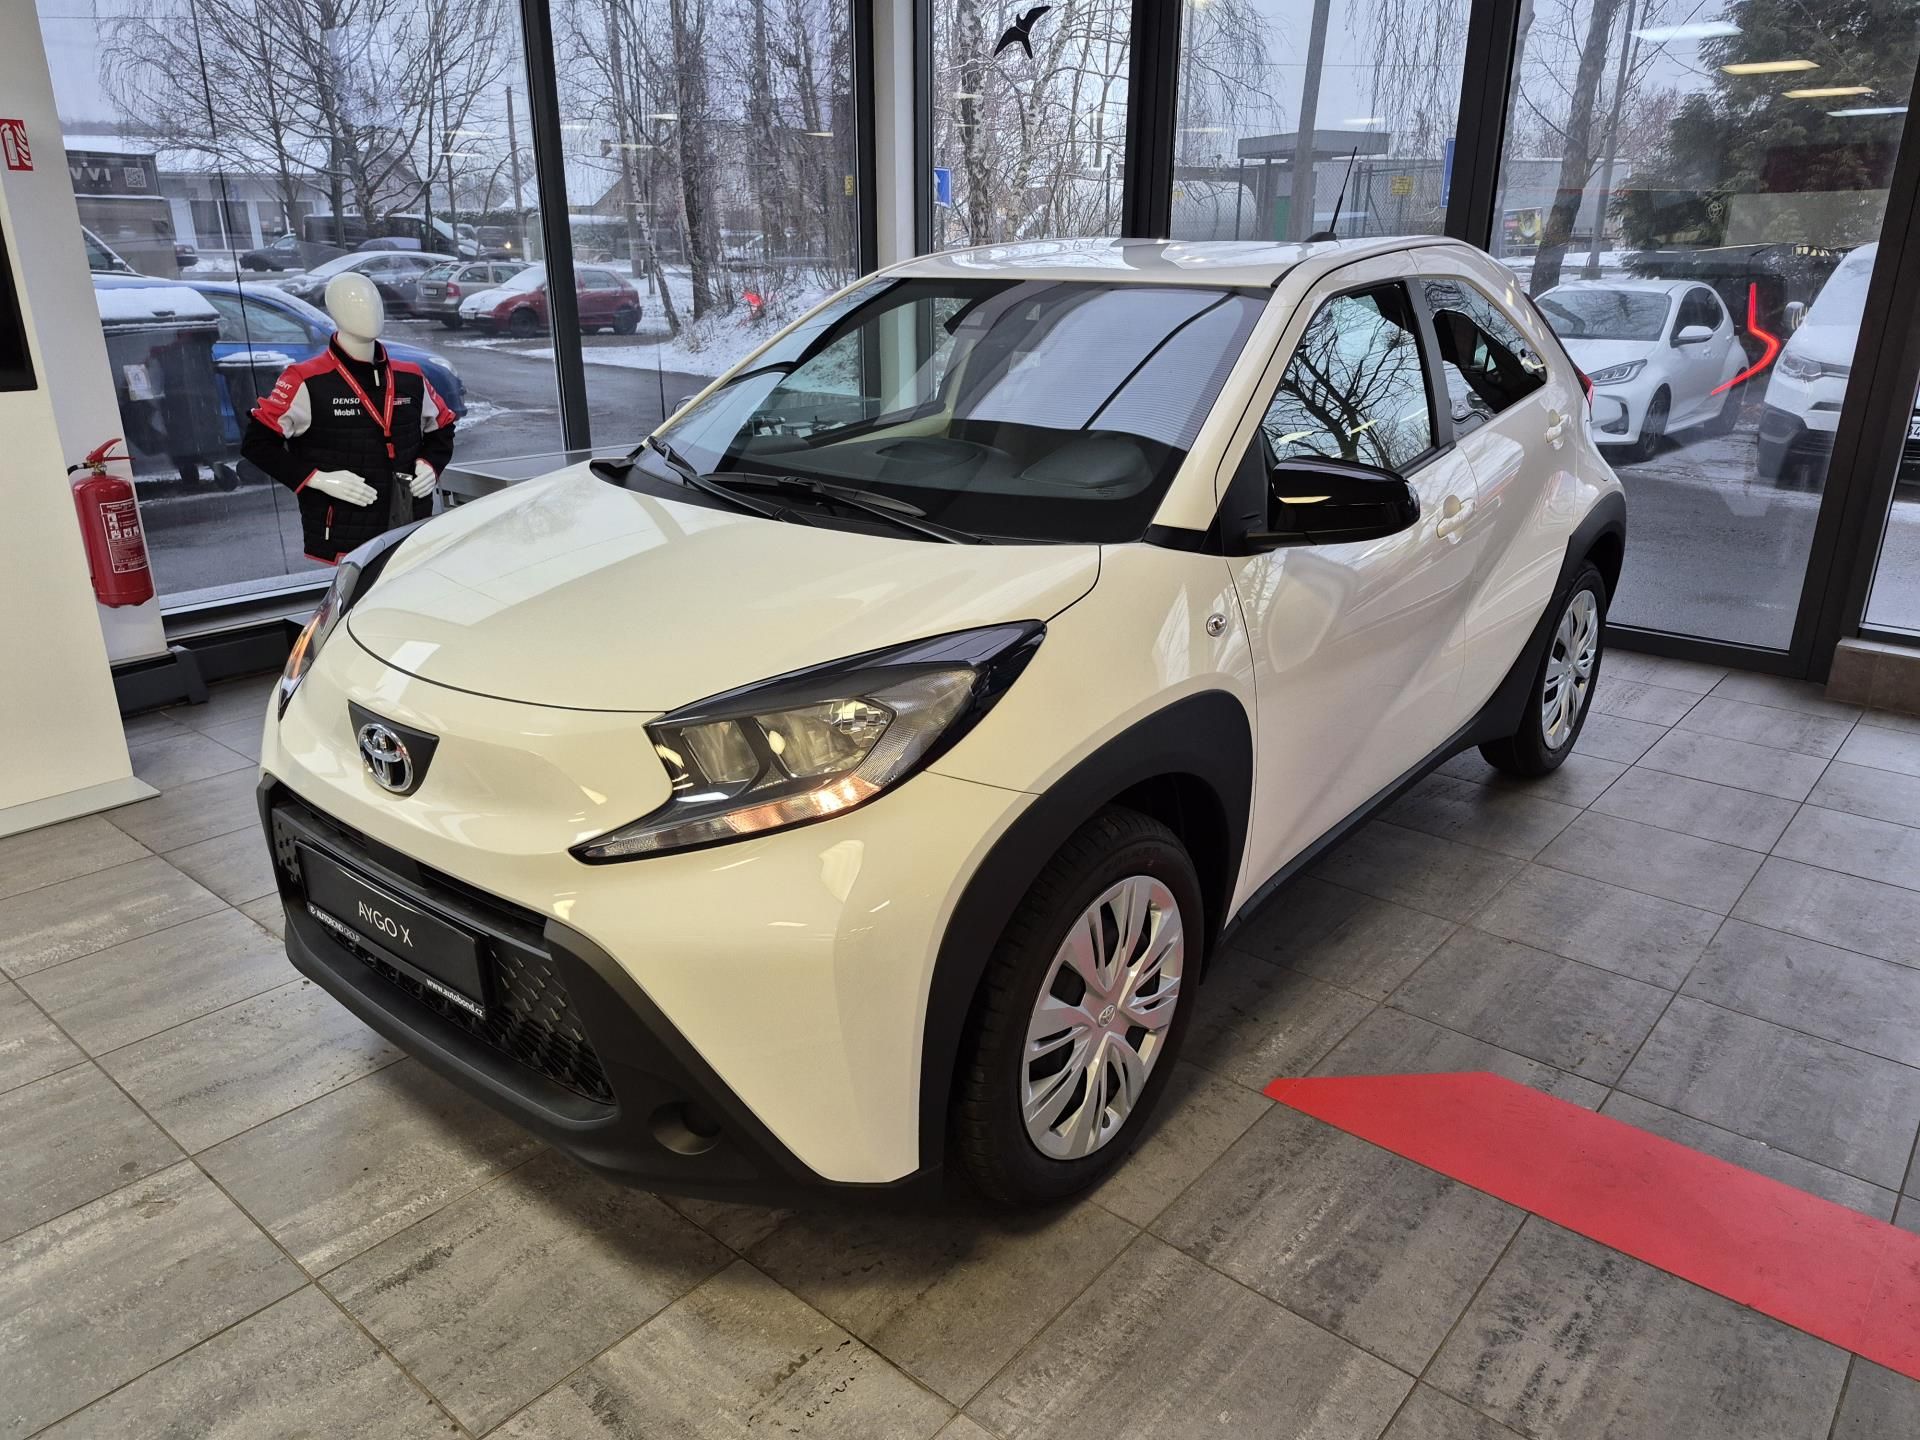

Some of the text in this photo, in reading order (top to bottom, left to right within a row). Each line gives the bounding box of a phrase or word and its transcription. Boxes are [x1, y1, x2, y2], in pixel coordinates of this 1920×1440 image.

[333, 397, 360, 405] DENSO
[334, 408, 355, 417] Mobil
[316, 910, 361, 943] AUTOBOND GROUP
[359, 900, 413, 948] AYGO X
[426, 978, 483, 1017] www.autobond.cz
